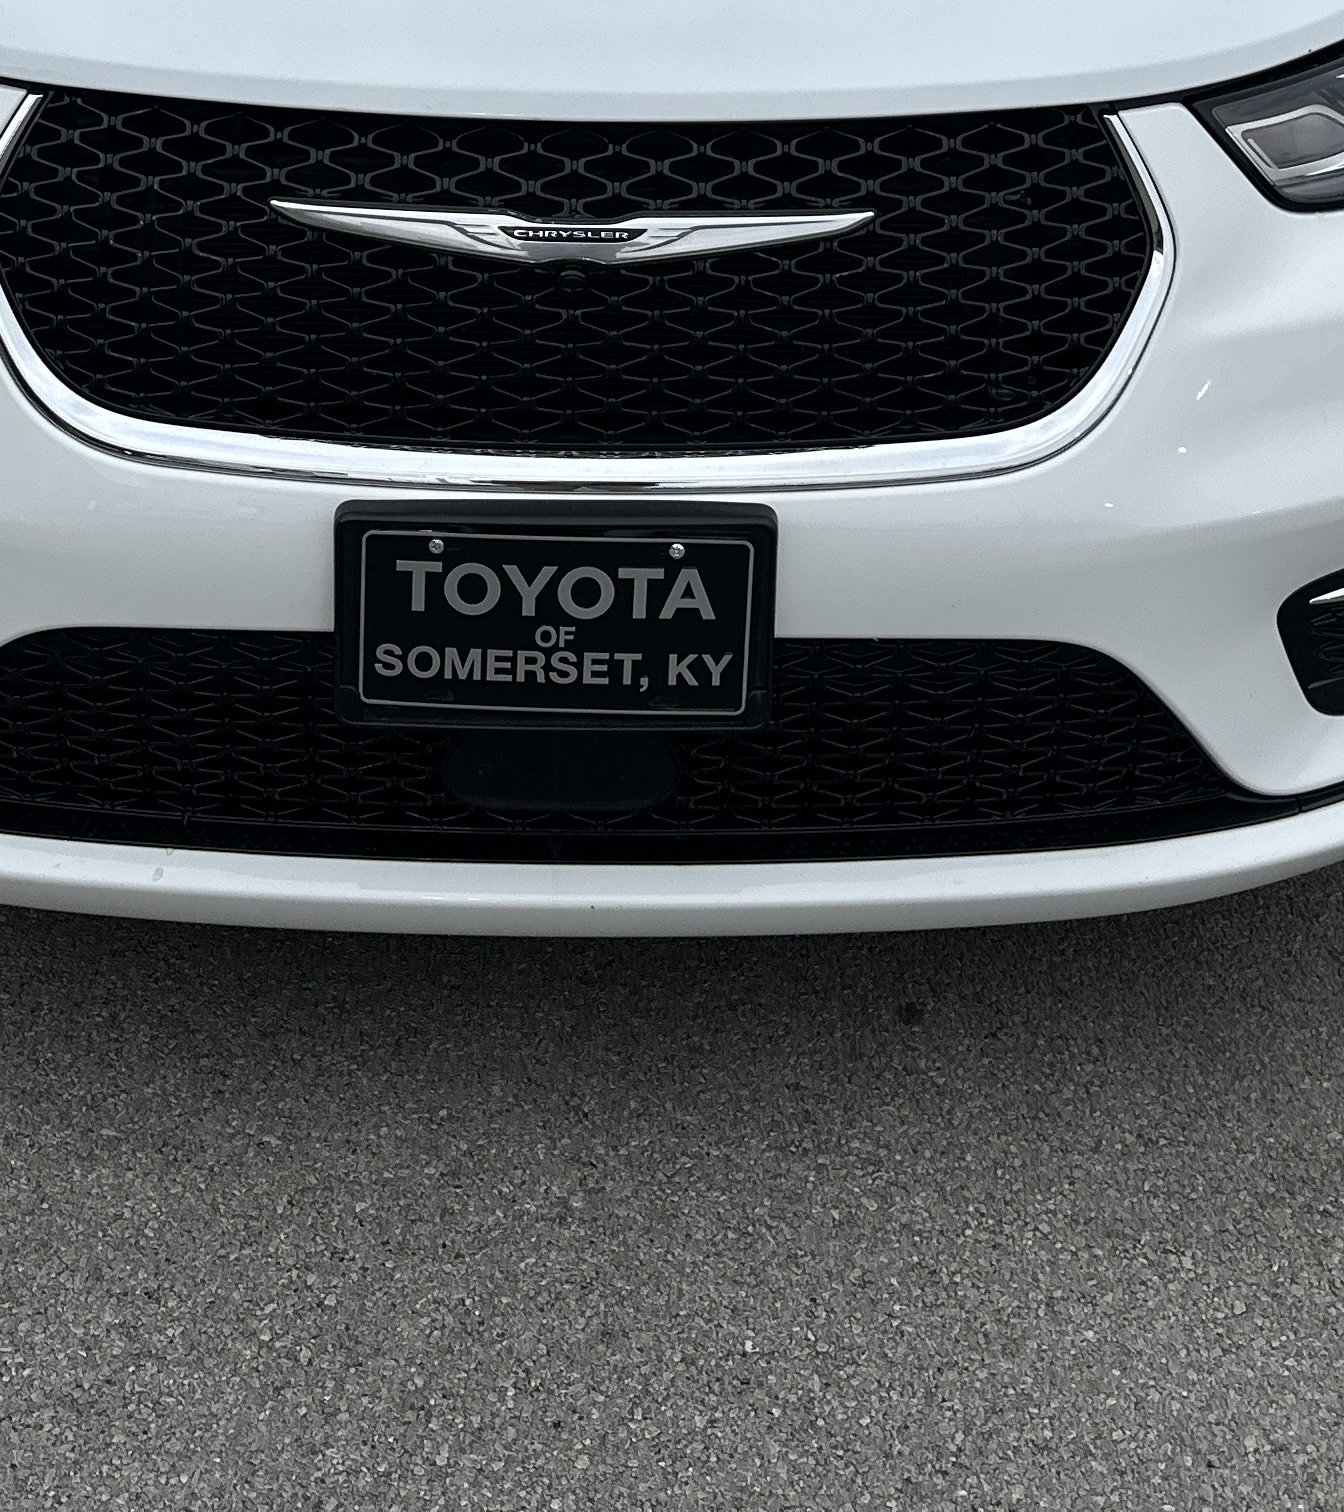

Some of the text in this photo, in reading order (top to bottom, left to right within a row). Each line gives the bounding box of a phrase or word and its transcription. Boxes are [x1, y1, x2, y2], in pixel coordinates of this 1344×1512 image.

[513, 229, 629, 239] CHRYSLER
[395, 559, 716, 620] TOYOTA
[534, 624, 576, 648] OF
[374, 643, 733, 692] SOMERSET, KY
